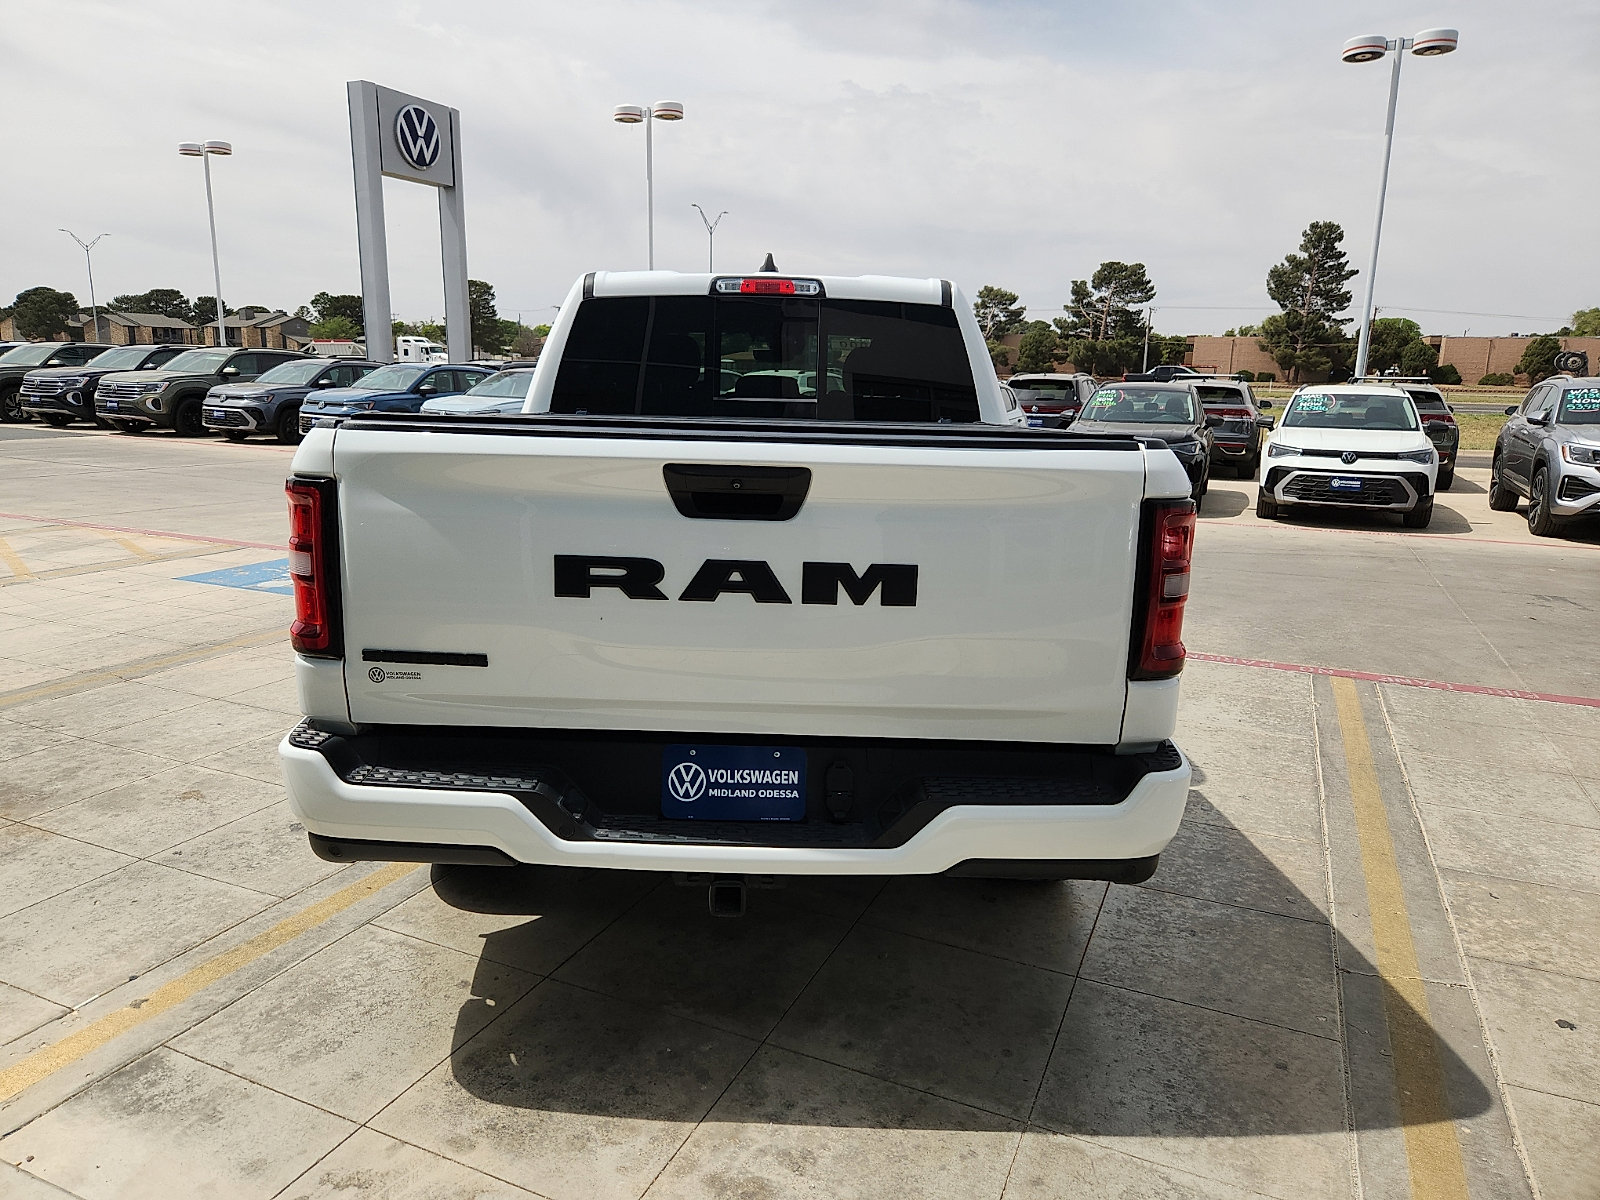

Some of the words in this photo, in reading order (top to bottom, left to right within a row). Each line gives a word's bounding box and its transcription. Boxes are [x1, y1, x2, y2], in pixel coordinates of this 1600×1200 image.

[553, 553, 919, 607] RAM
[1186, 652, 1275, 668] PARKIN
[708, 768, 799, 785] VOLKSWAGEN
[708, 788, 757, 798] MIDLAND
[758, 789, 800, 799] ODESSA
